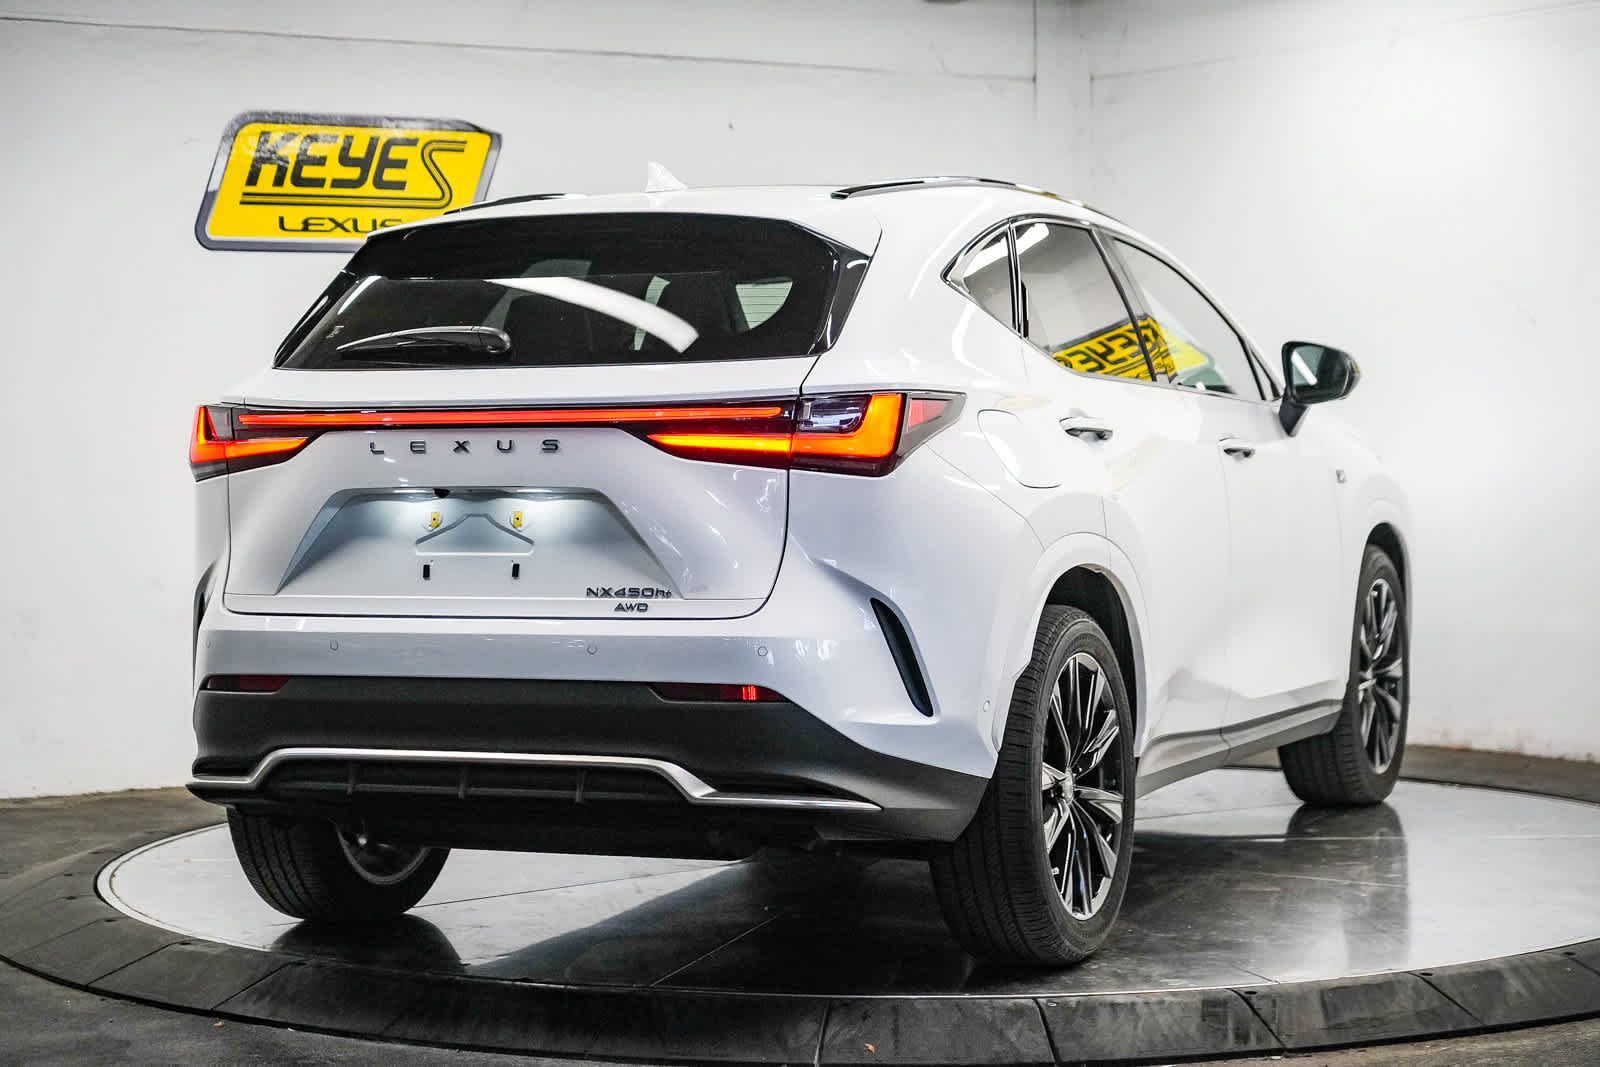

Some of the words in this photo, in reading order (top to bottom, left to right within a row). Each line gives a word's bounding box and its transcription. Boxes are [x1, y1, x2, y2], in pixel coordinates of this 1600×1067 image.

[241, 130, 467, 208] KEYES
[369, 439, 560, 455] LEXUS
[586, 587, 672, 598] NX450h+
[614, 602, 649, 613] AWD
